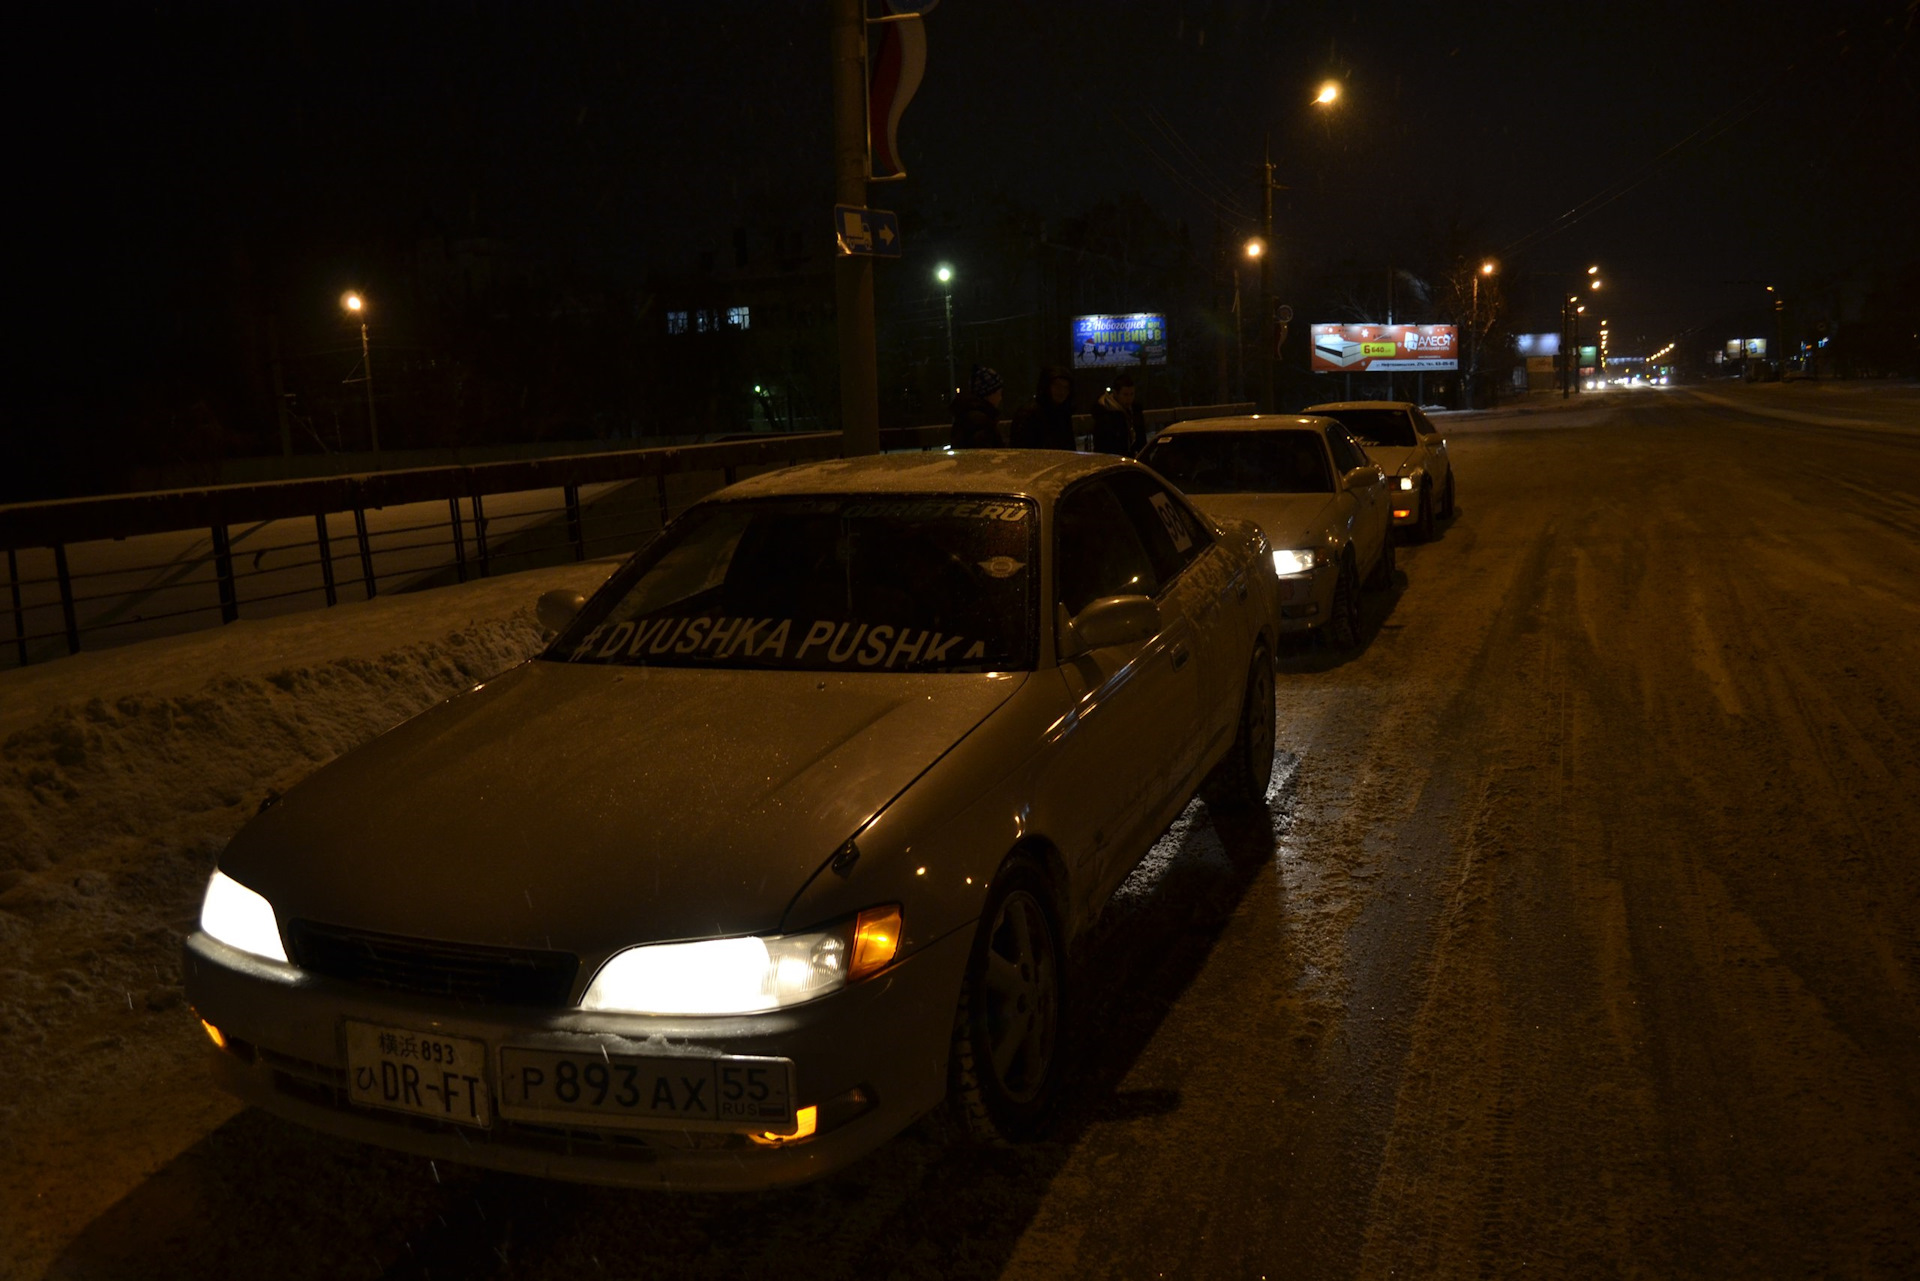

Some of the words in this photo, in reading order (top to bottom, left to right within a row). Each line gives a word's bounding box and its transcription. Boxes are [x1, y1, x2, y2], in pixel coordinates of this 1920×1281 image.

[1080, 322, 1092, 332] 22
[1418, 335, 1451, 347] АЛЕСЯ
[567, 617, 793, 662] #DVUSHKA
[379, 1032, 419, 1059] 横浜
[421, 1041, 454, 1065] 893
[381, 1060, 480, 1118] DR-FT
[722, 1067, 770, 1102] 55
[722, 1101, 758, 1117] RUS
